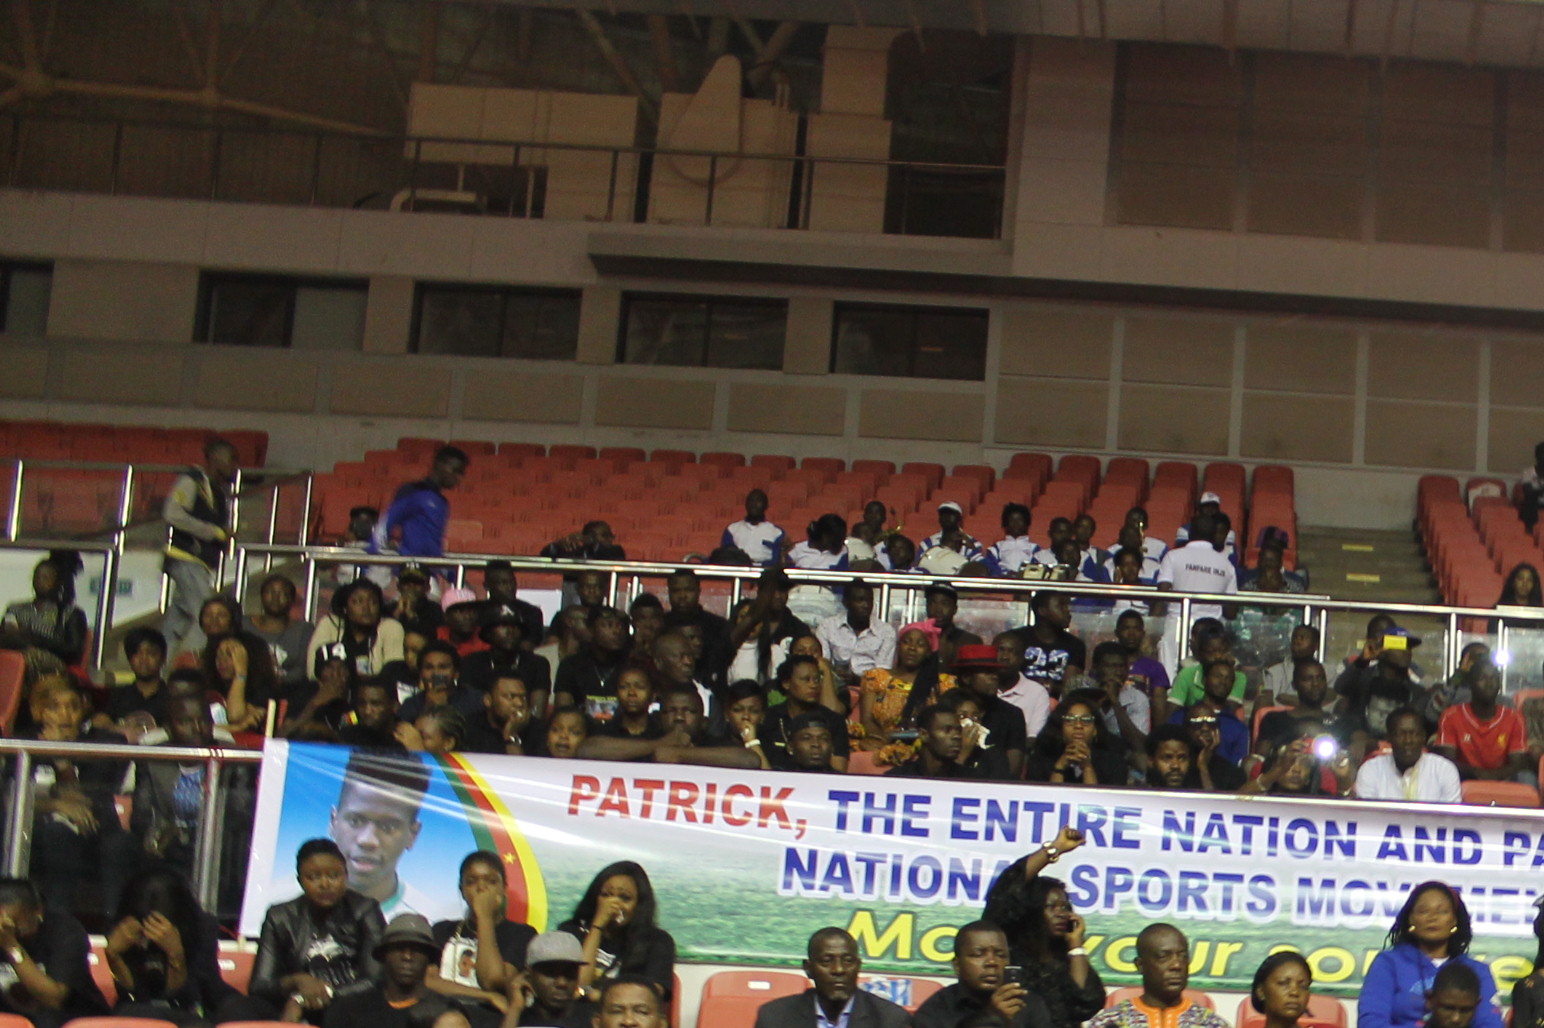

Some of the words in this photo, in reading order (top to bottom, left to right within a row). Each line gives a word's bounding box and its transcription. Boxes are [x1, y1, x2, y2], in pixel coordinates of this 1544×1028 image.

[567, 774, 807, 840] PATRICK,
[828, 790, 931, 838] THE
[950, 797, 1141, 850] ENTIRE
[1161, 811, 1356, 861] NATION
[1377, 824, 1483, 865] AND
[781, 847, 1011, 901] NATION
[1067, 864, 1276, 918] SPORTS
